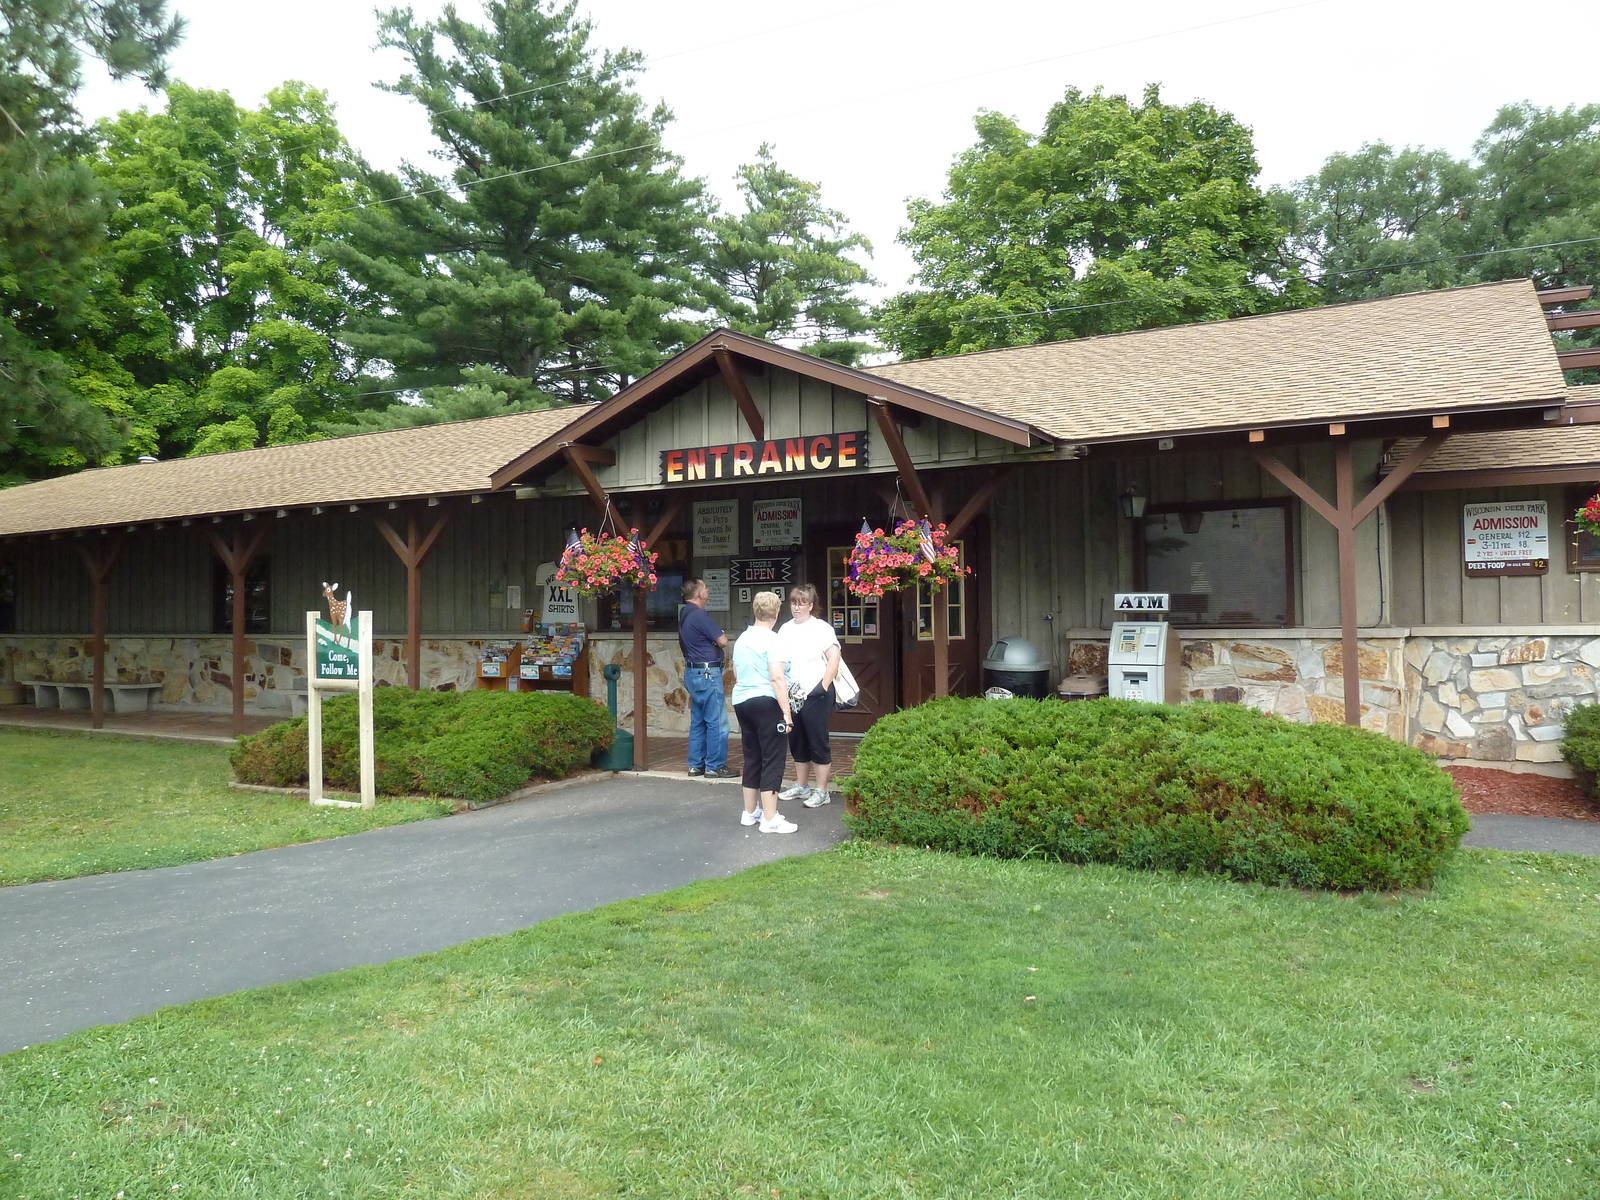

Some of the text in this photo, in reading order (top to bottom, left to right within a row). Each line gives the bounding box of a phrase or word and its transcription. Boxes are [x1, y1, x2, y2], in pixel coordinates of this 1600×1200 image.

[667, 433, 857, 482] ENTRANCE
[757, 509, 798, 521] ADMISSION
[1466, 505, 1502, 517] WISCONSIN
[1527, 504, 1546, 514] PARK
[1472, 516, 1538, 531] ADMISSION
[1478, 532, 1513, 541] GENERAL
[1482, 541, 1500, 550] 3-11
[749, 560, 772, 568] HOURS
[1467, 562, 1487, 570] DEER
[1487, 561, 1506, 569] FOOD
[745, 567, 775, 581] OPEN
[549, 585, 573, 603] XXL
[742, 589, 748, 600] 9
[1119, 595, 1164, 609] ATM
[548, 604, 575, 614] SHIRTS
[328, 649, 349, 663] Come,
[320, 663, 358, 676] Follow Me
